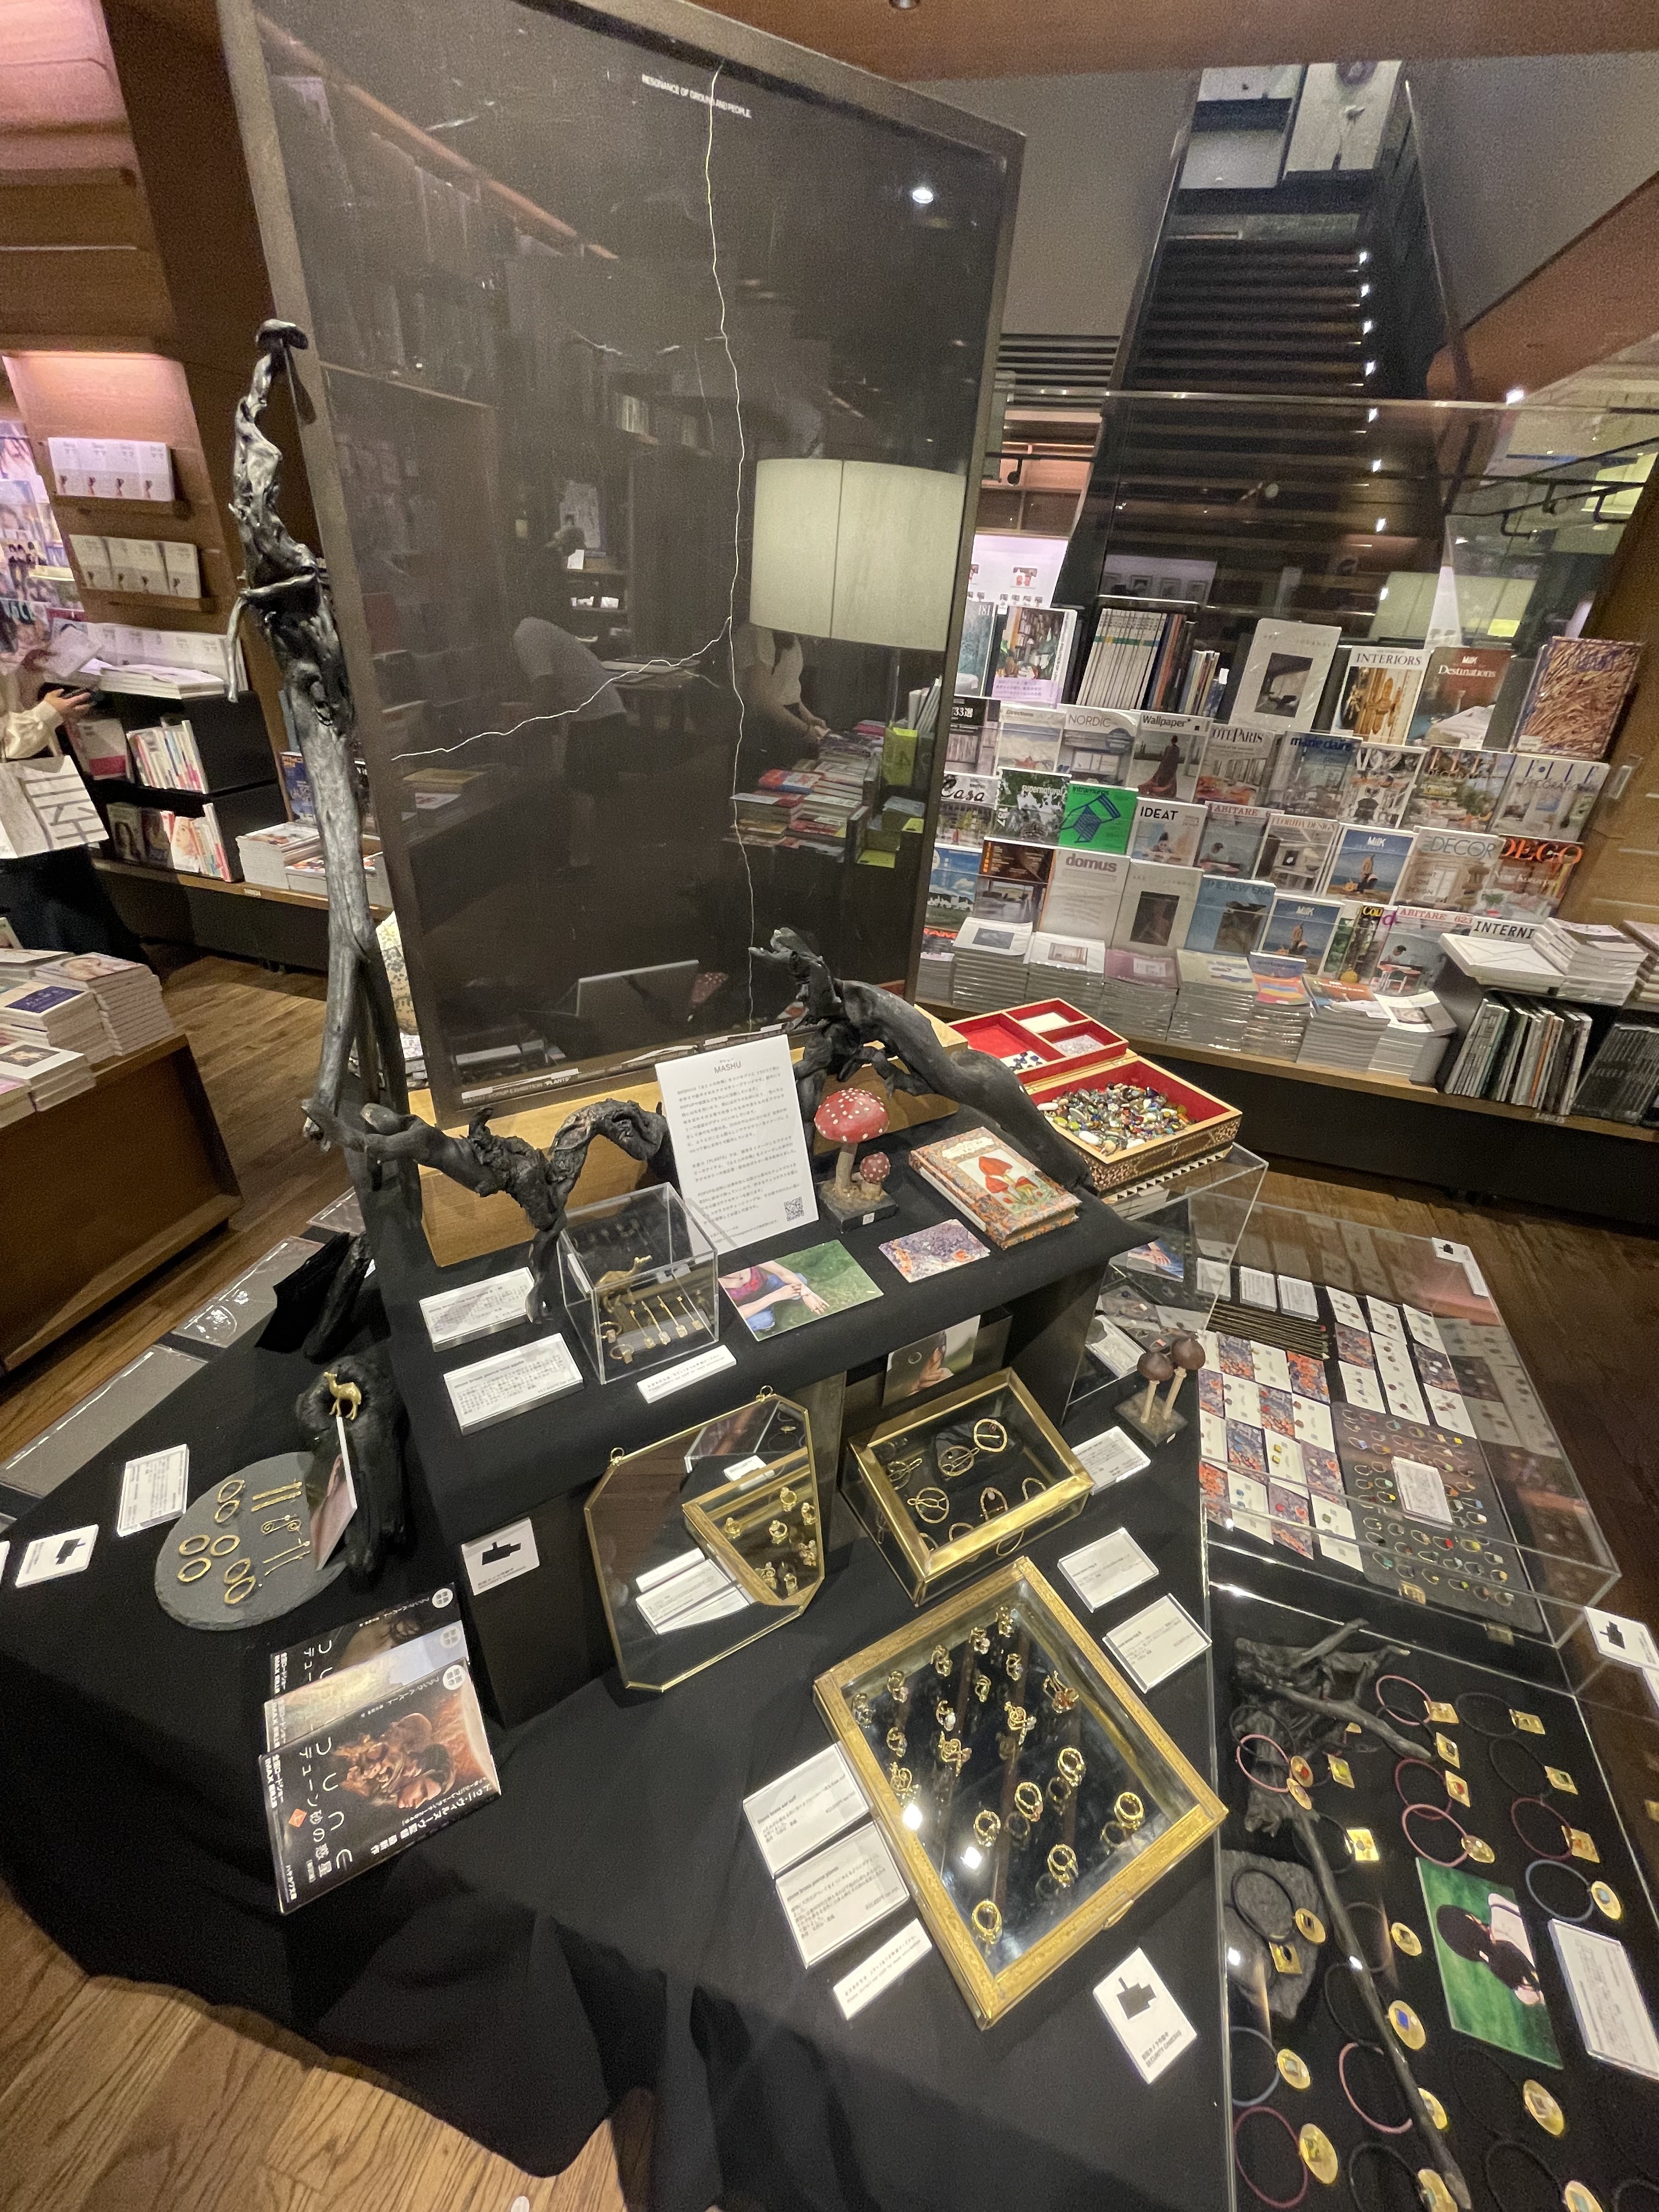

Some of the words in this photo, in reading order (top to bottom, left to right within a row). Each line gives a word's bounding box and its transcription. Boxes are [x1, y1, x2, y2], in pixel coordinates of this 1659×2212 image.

[1356, 652, 1422, 667] INTERIORS
[1438, 665, 1496, 679] Destinations
[1006, 709, 1034, 718] Directions
[1068, 714, 1111, 727] NORDIC
[1290, 736, 1323, 748] marie
[1323, 738, 1353, 752] claire
[941, 775, 985, 802] Casa
[1021, 784, 1064, 797] supernatural
[1072, 786, 1109, 795] Intramuros
[1140, 806, 1178, 821] IDEAT
[1214, 805, 1259, 816] ABITARE
[1272, 816, 1306, 827] FLORIDA
[1306, 820, 1335, 831] DESIGN
[1430, 837, 1496, 859] DECOR
[1065, 854, 1118, 872] domus
[1227, 883, 1249, 893] NEW
[1252, 887, 1271, 896] ERA
[1400, 909, 1446, 921] ABITARE
[1454, 916, 1473, 926] 623
[1474, 921, 1535, 939] INTERNI
[714, 1061, 742, 1074] MASHU
[264, 1757, 274, 1784] IMAX
